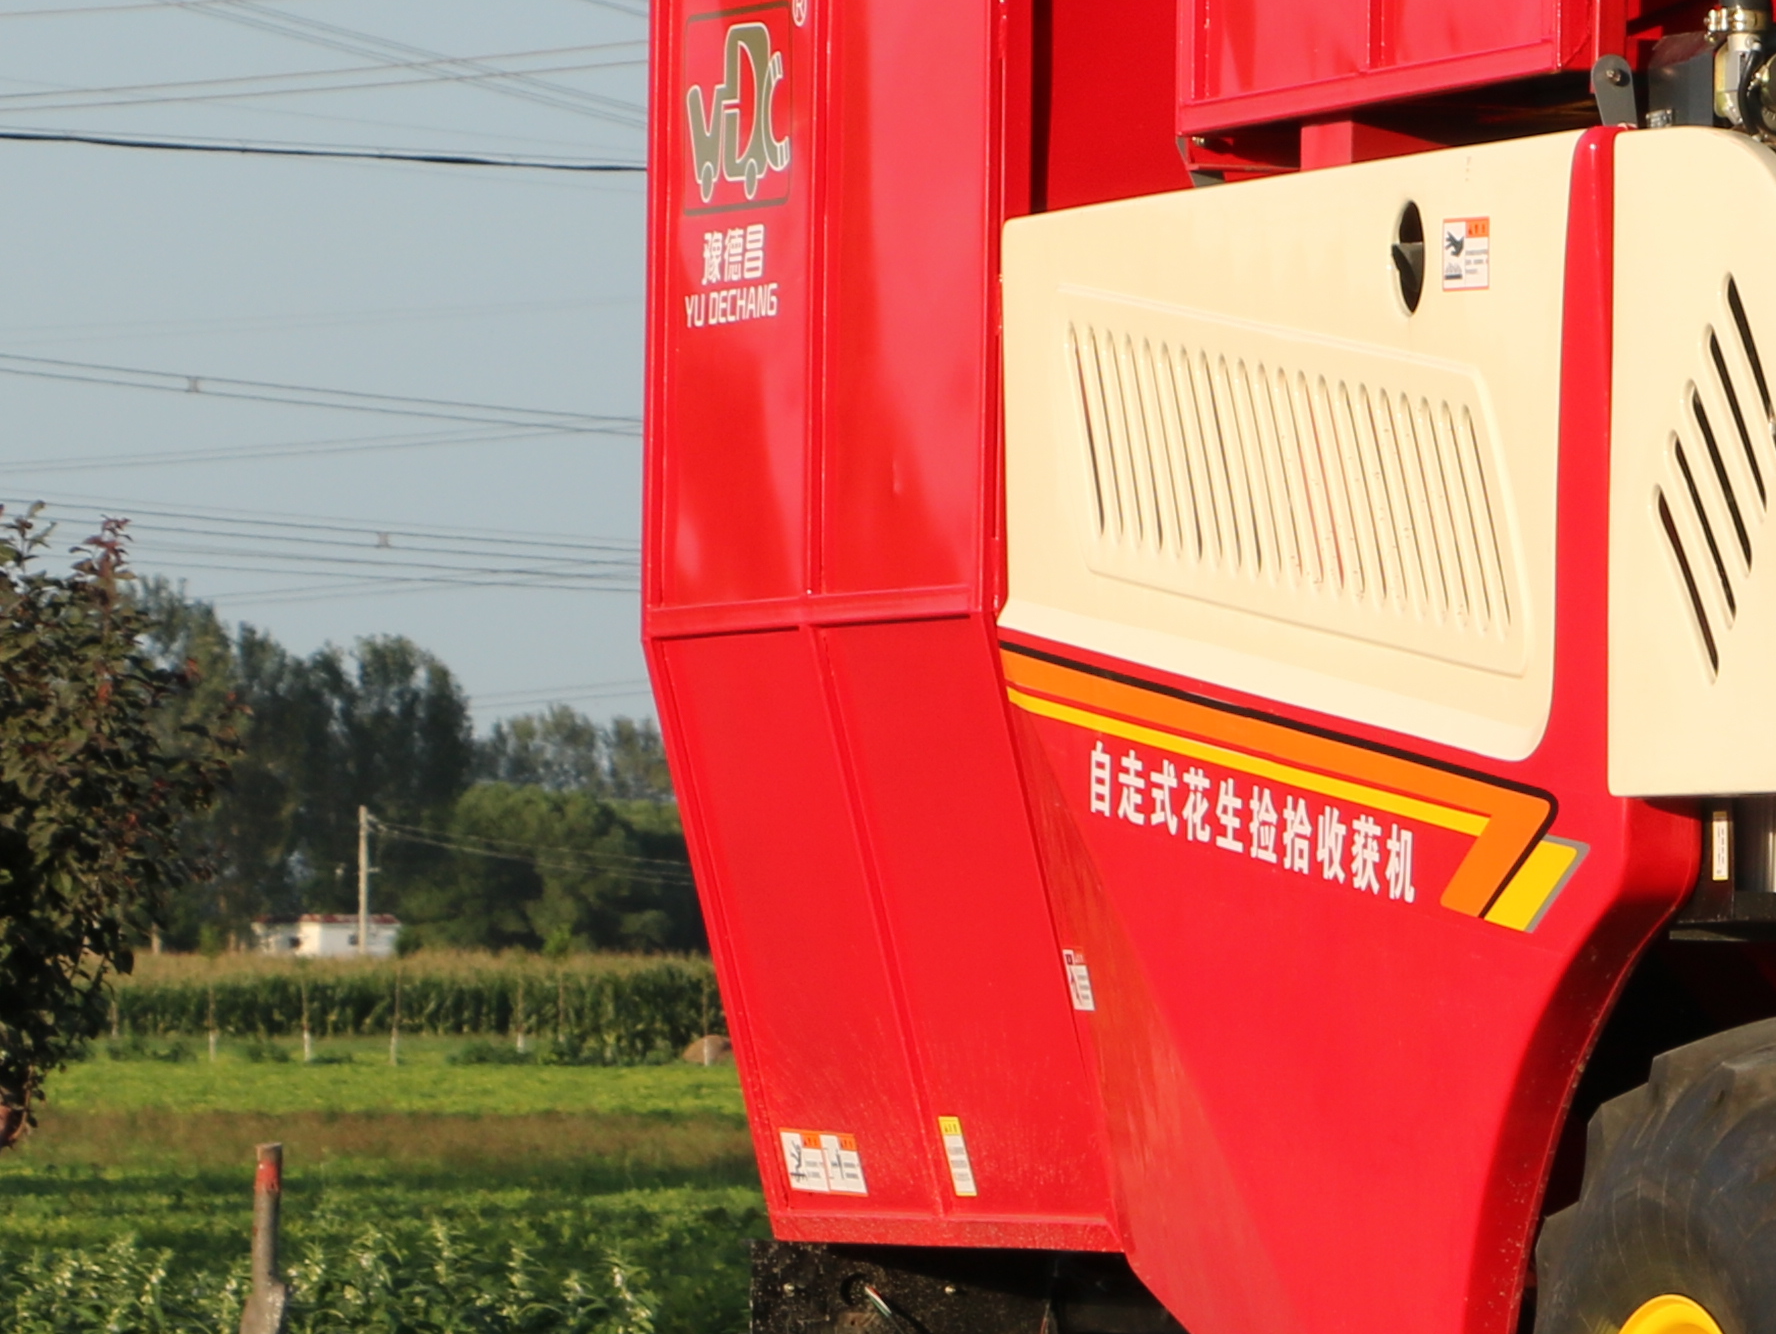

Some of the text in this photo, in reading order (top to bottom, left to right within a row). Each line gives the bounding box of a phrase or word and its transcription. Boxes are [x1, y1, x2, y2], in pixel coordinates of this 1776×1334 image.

[701, 223, 765, 286] 豫德昌
[684, 282, 779, 328] YU DECHANG
[1089, 740, 1416, 904] 自走式花生捡拾收获机
